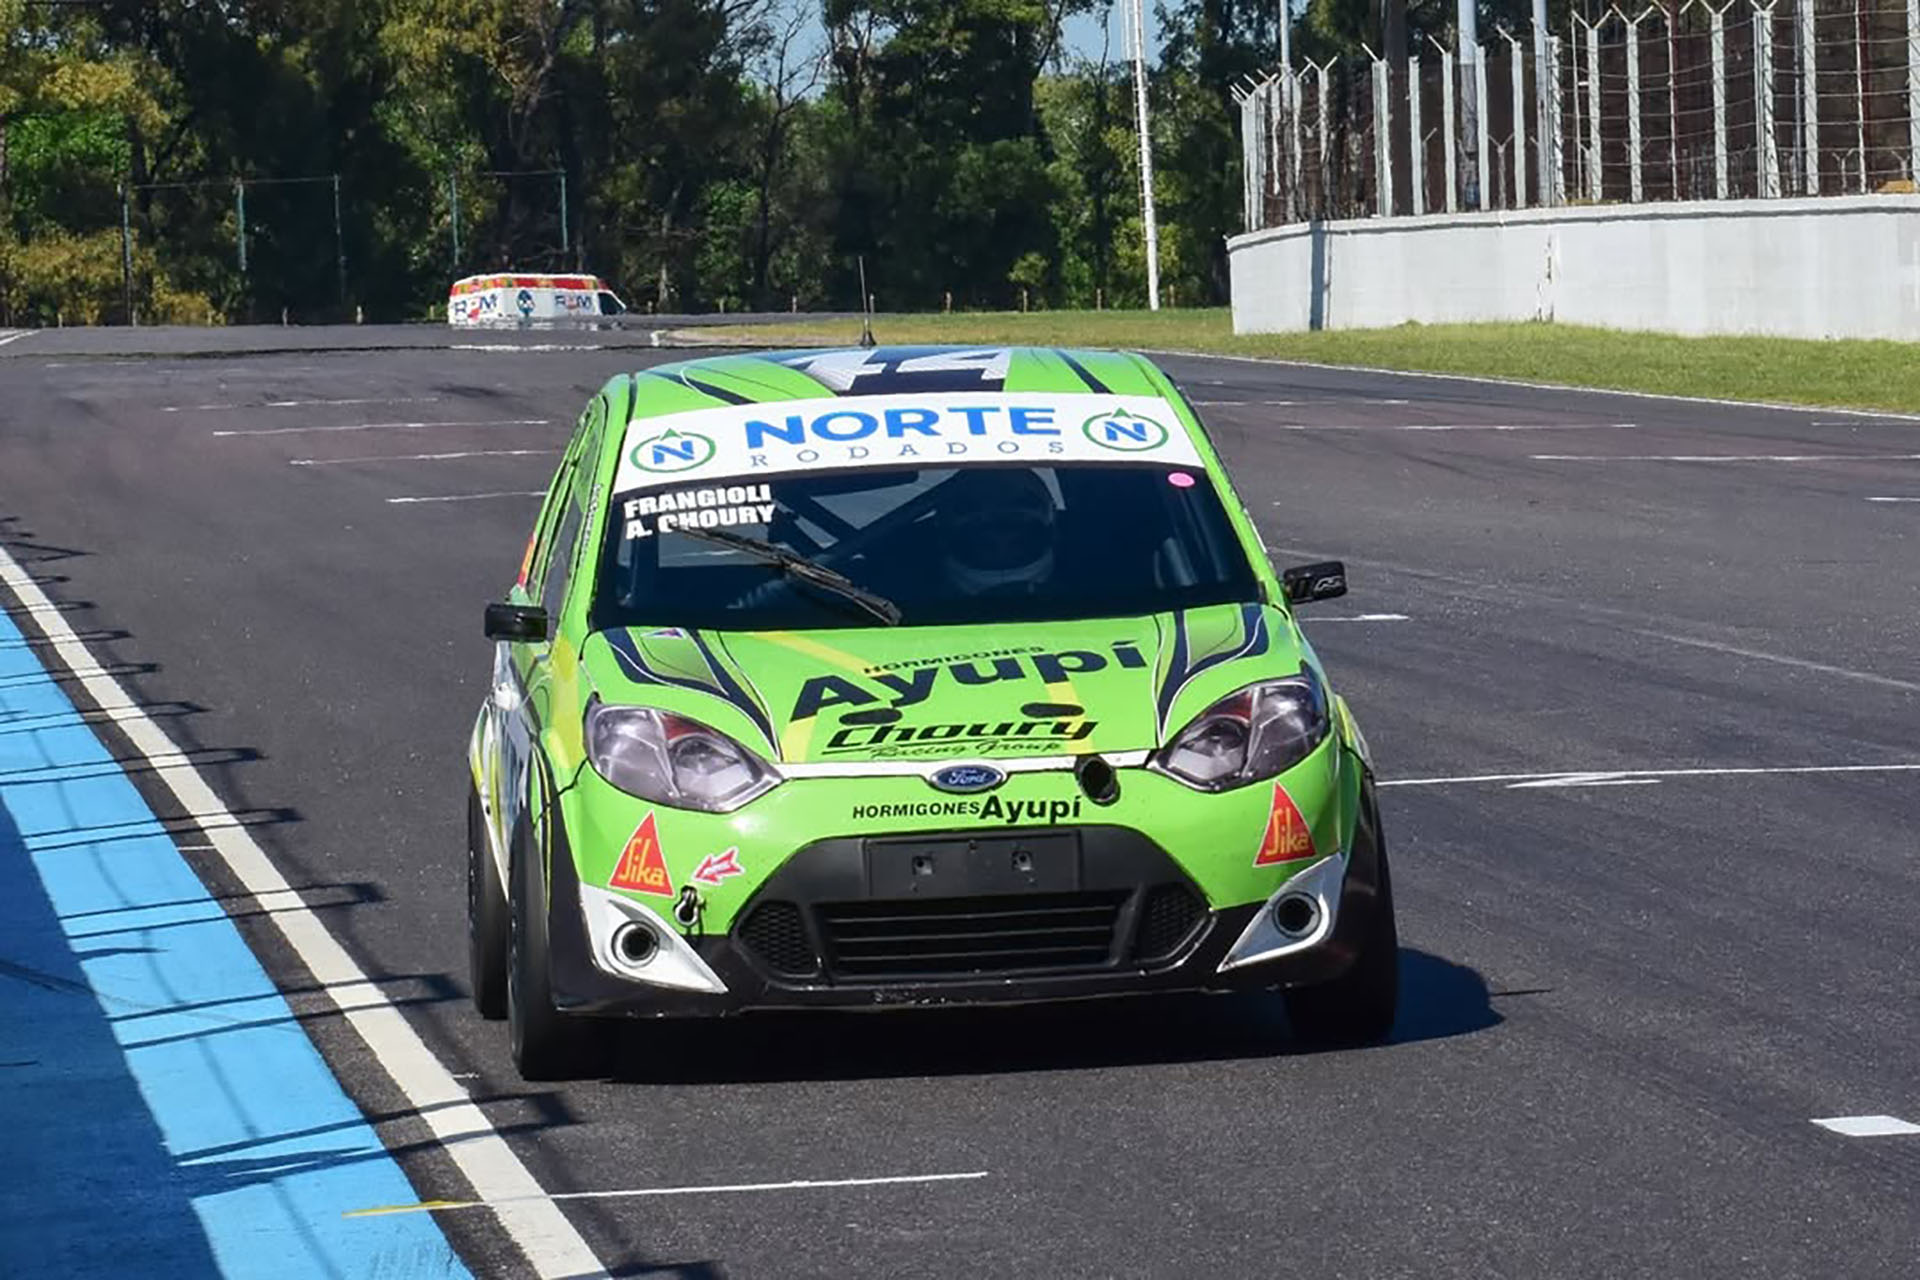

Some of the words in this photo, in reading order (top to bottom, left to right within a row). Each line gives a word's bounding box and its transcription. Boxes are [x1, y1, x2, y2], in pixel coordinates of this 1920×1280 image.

[744, 406, 1062, 449] NORTE
[750, 440, 1064, 467] RODADOS
[623, 484, 772, 519] FRANGIOLI
[625, 518, 653, 540] A.
[657, 504, 776, 533] CHOURY
[863, 646, 1046, 674] HORMIGONES
[948, 771, 987, 785] Ford
[852, 801, 981, 820] HORMIGONES
[1265, 806, 1310, 856] Sika
[617, 838, 666, 888] Sika
